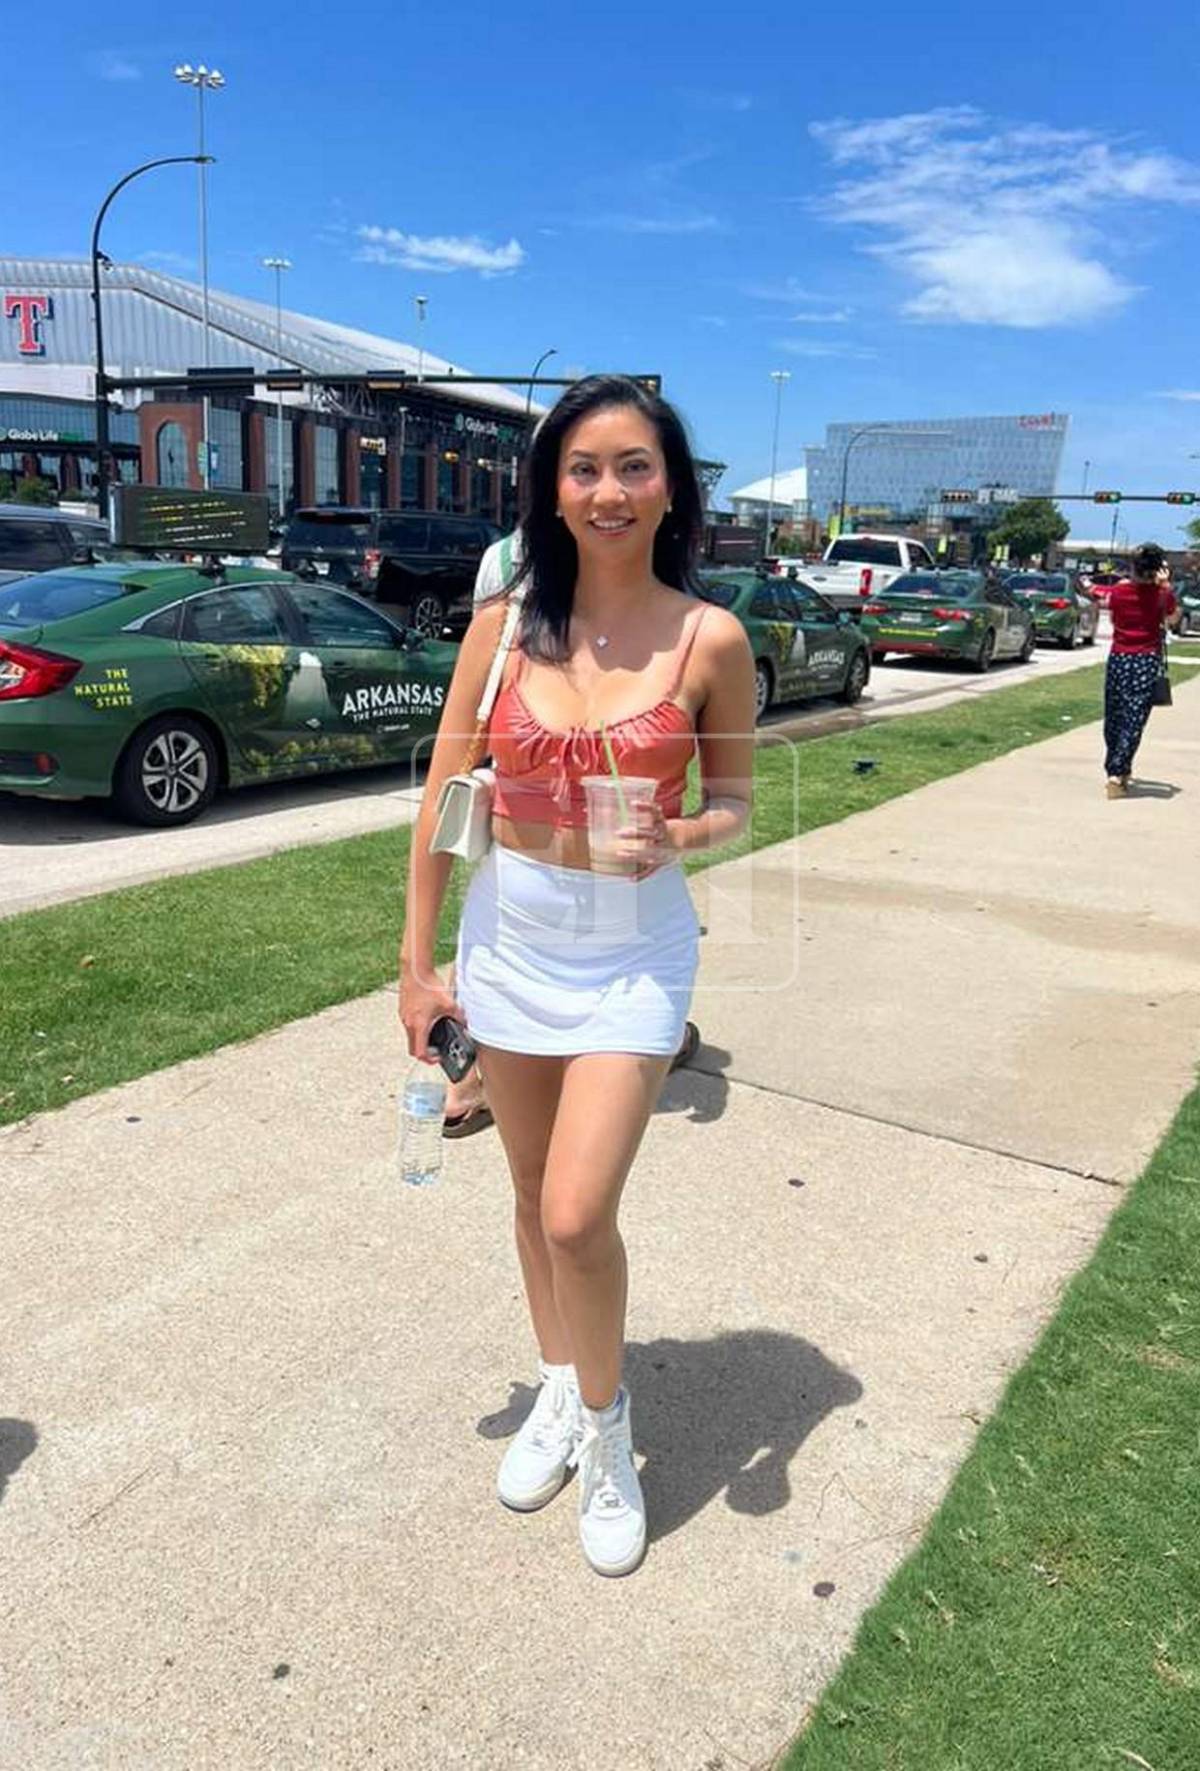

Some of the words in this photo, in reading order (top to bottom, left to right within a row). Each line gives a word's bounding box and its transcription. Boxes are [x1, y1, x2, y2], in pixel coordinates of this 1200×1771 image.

[4, 294, 53, 356] T
[105, 668, 128, 679] THE
[74, 682, 130, 696] NATURAL
[96, 695, 133, 708] STATE
[342, 684, 443, 716] ARKANSAS
[353, 710, 370, 722] THE
[373, 706, 408, 717] NATURAL
[410, 705, 433, 716] STATE
